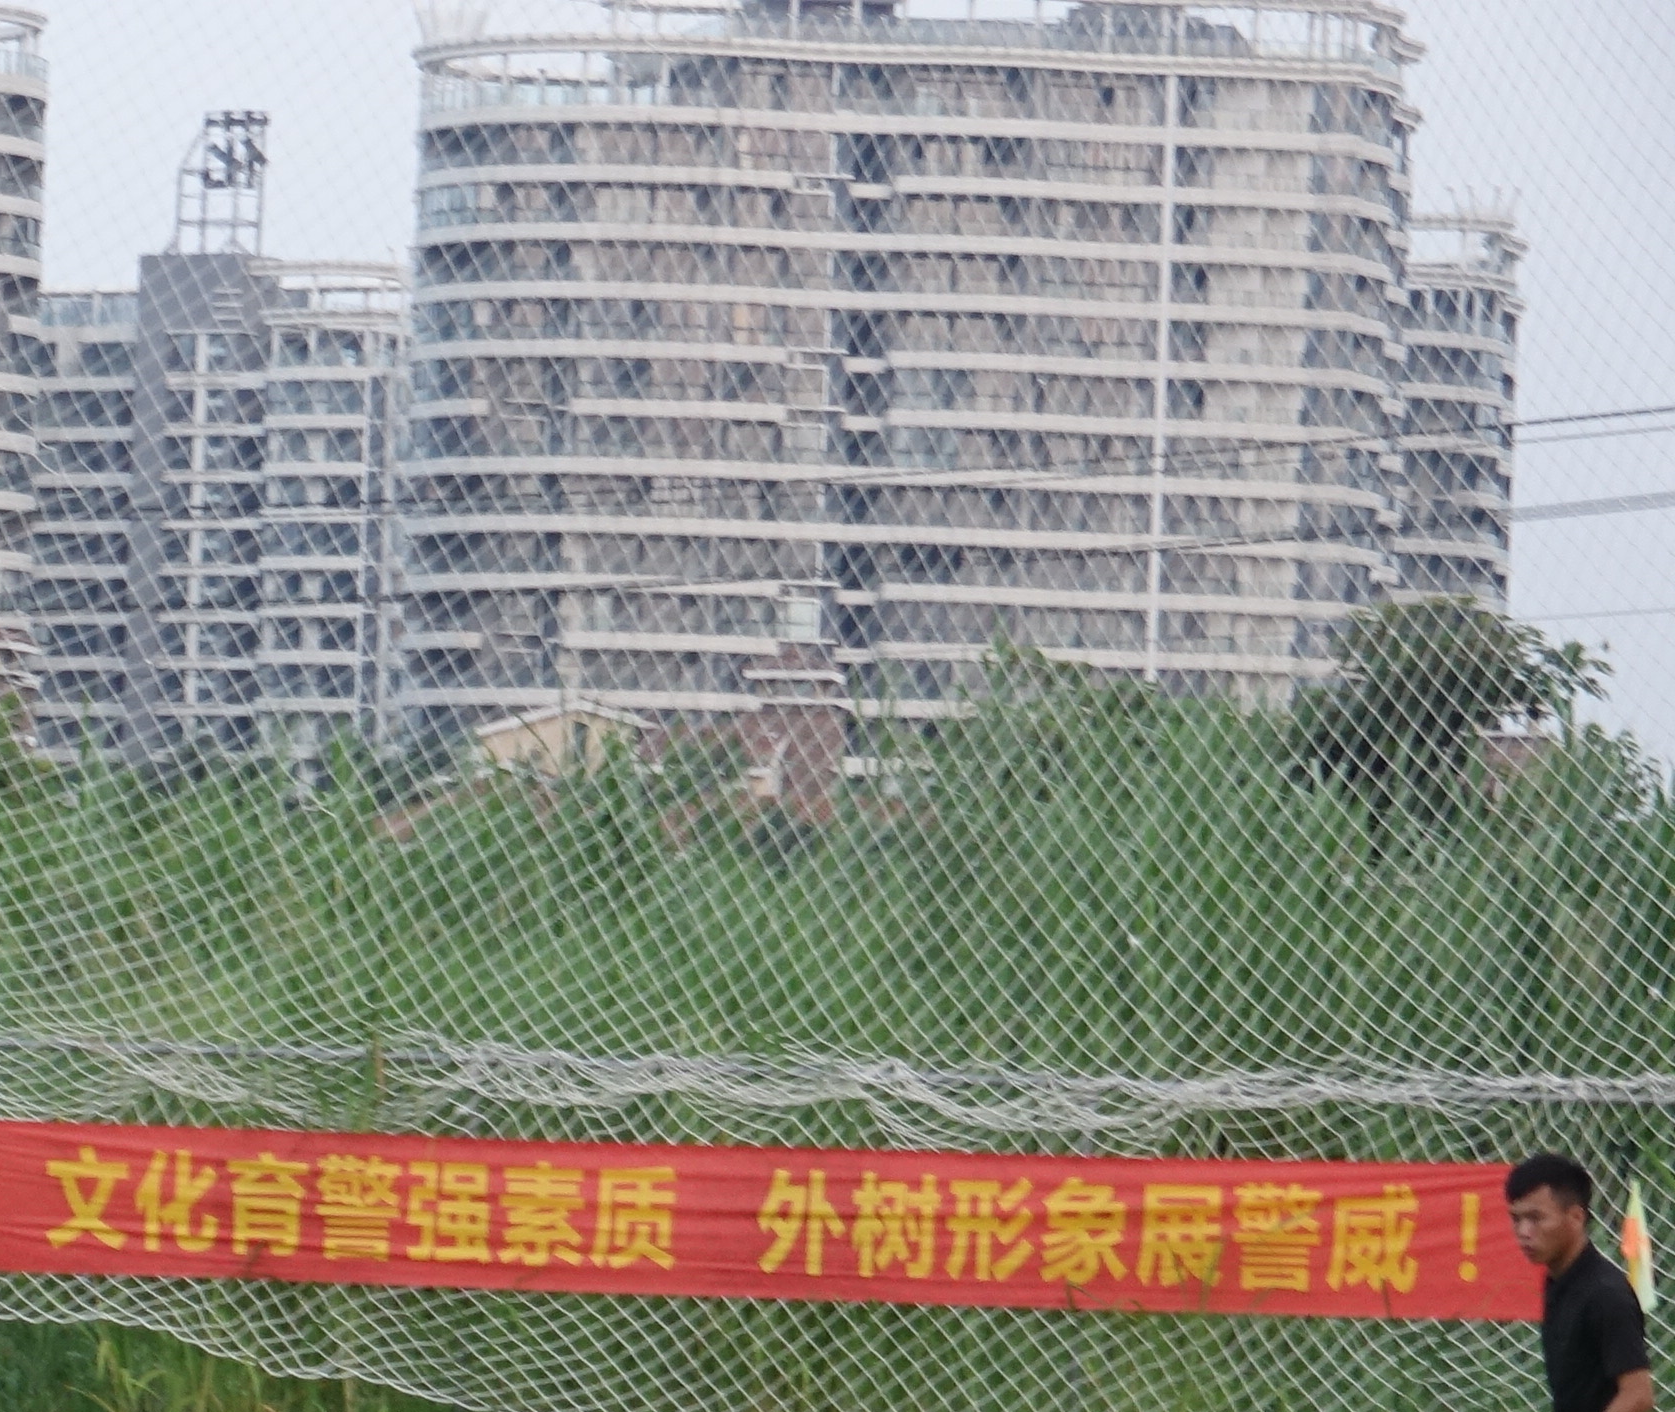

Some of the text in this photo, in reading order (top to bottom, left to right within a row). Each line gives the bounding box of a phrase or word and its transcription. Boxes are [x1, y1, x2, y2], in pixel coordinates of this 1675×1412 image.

[45, 1146, 1481, 1294] 文化育警强素质 外树形象展警威！
